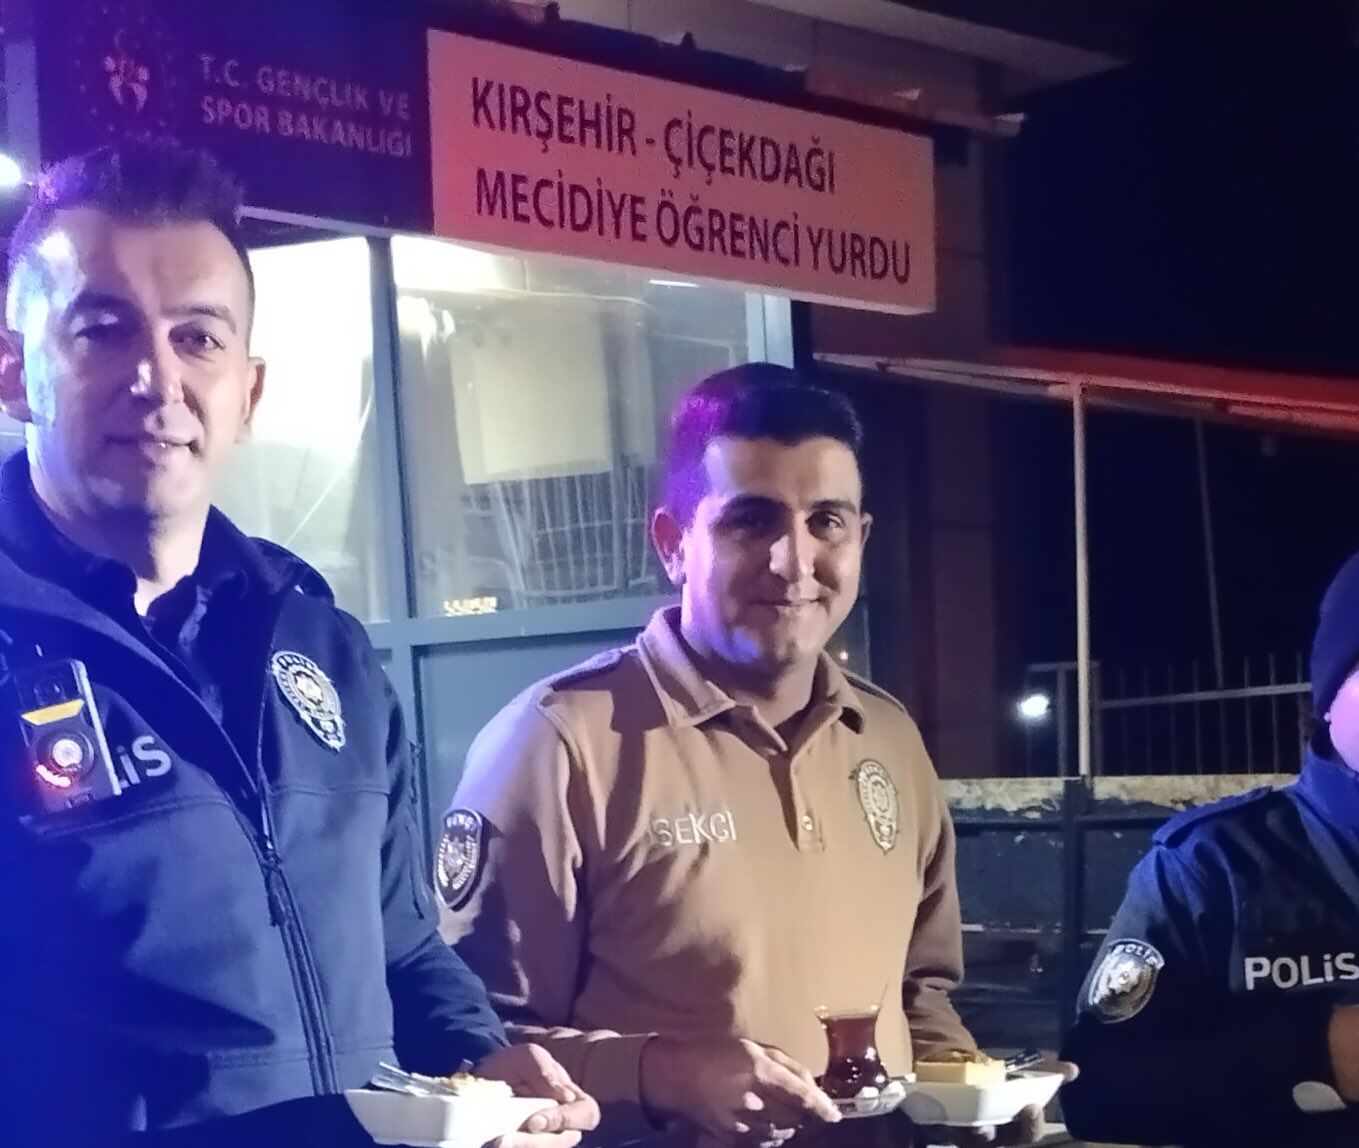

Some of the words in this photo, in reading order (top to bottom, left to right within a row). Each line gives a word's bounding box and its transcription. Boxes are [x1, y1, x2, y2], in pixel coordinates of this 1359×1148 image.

[200, 94, 271, 135] SPOR
[379, 88, 411, 122] VE
[471, 76, 637, 157] KIRŞEHİR
[664, 109, 837, 195] ÇİÇEKDAĞI
[476, 166, 648, 243] MECİDİYE
[655, 187, 801, 268] ÖĞRENCİ
[806, 224, 912, 285] YURDU
